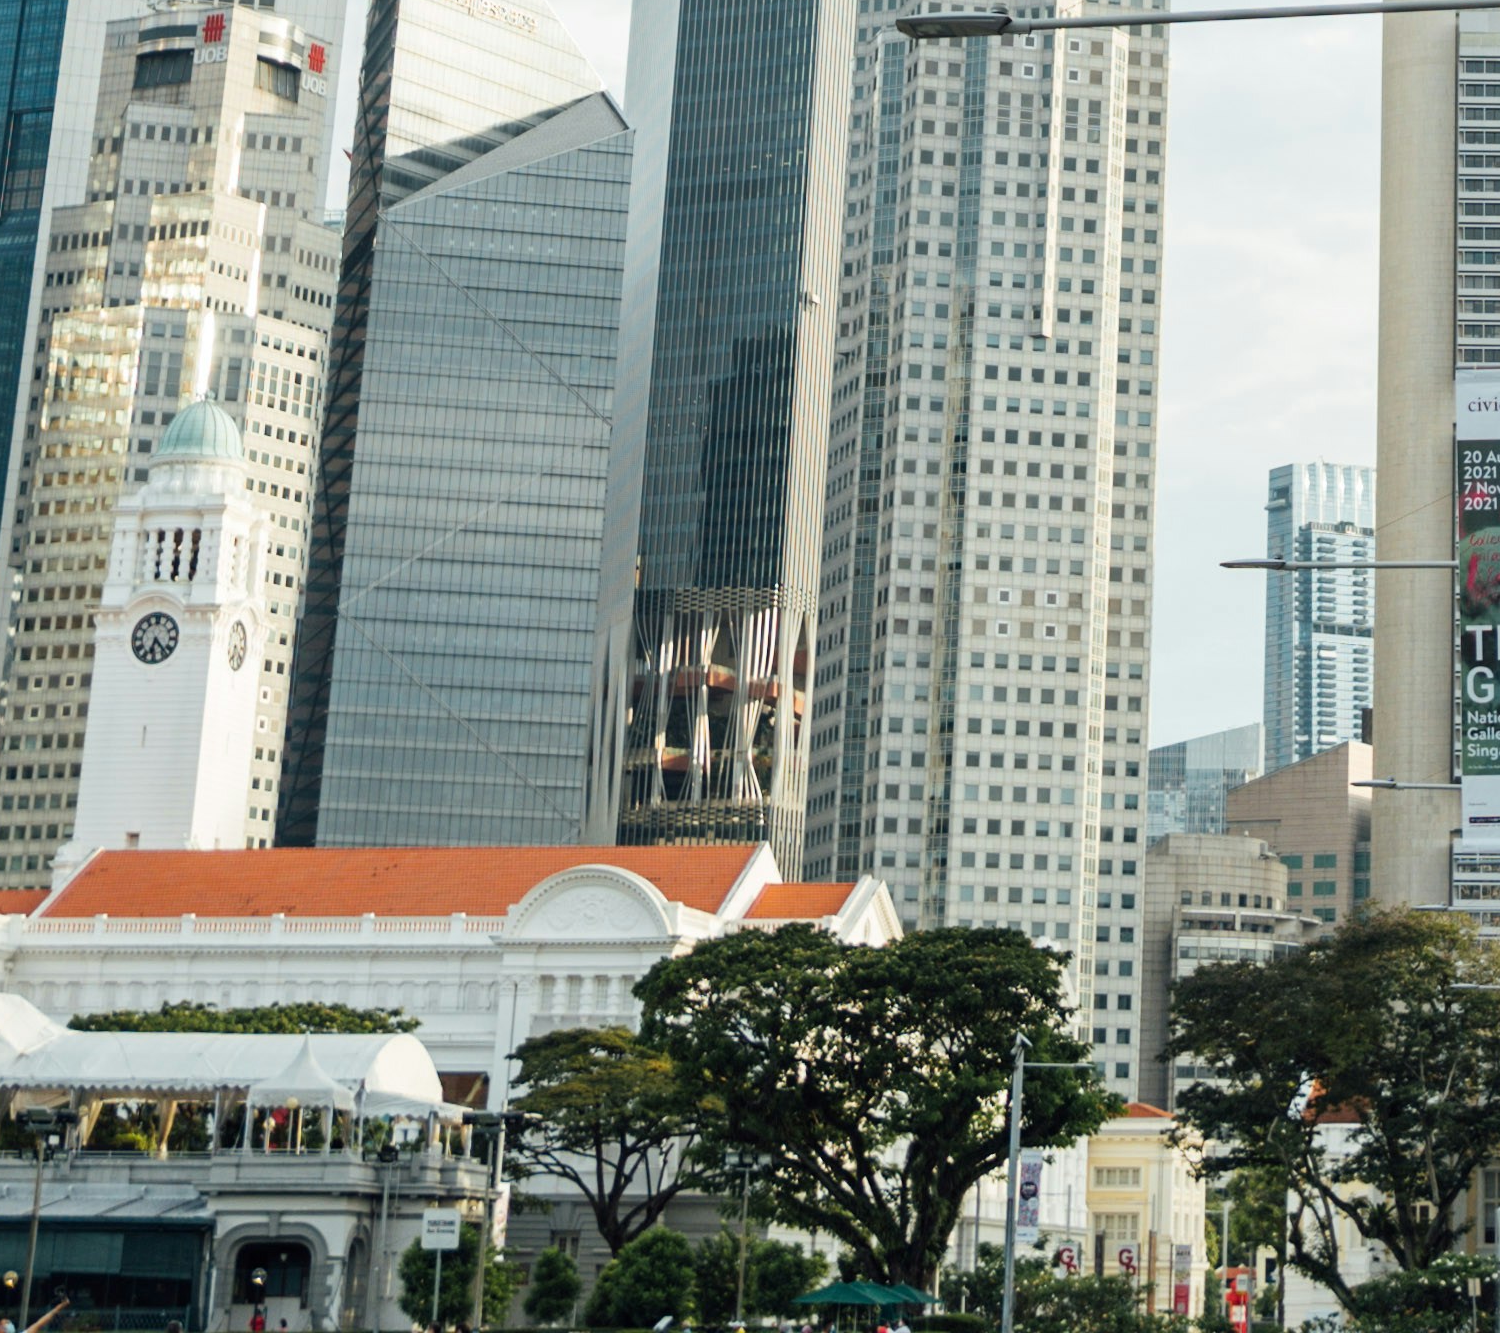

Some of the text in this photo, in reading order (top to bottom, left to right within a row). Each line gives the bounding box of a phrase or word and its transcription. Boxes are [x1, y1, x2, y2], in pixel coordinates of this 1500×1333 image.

[194, 46, 228, 65] UOB
[302, 73, 327, 97] UOB
[1463, 450, 1482, 464] 20
[1463, 466, 1497, 479] 2021
[1463, 482, 1472, 495] 7
[1464, 497, 1498, 510] 2021
